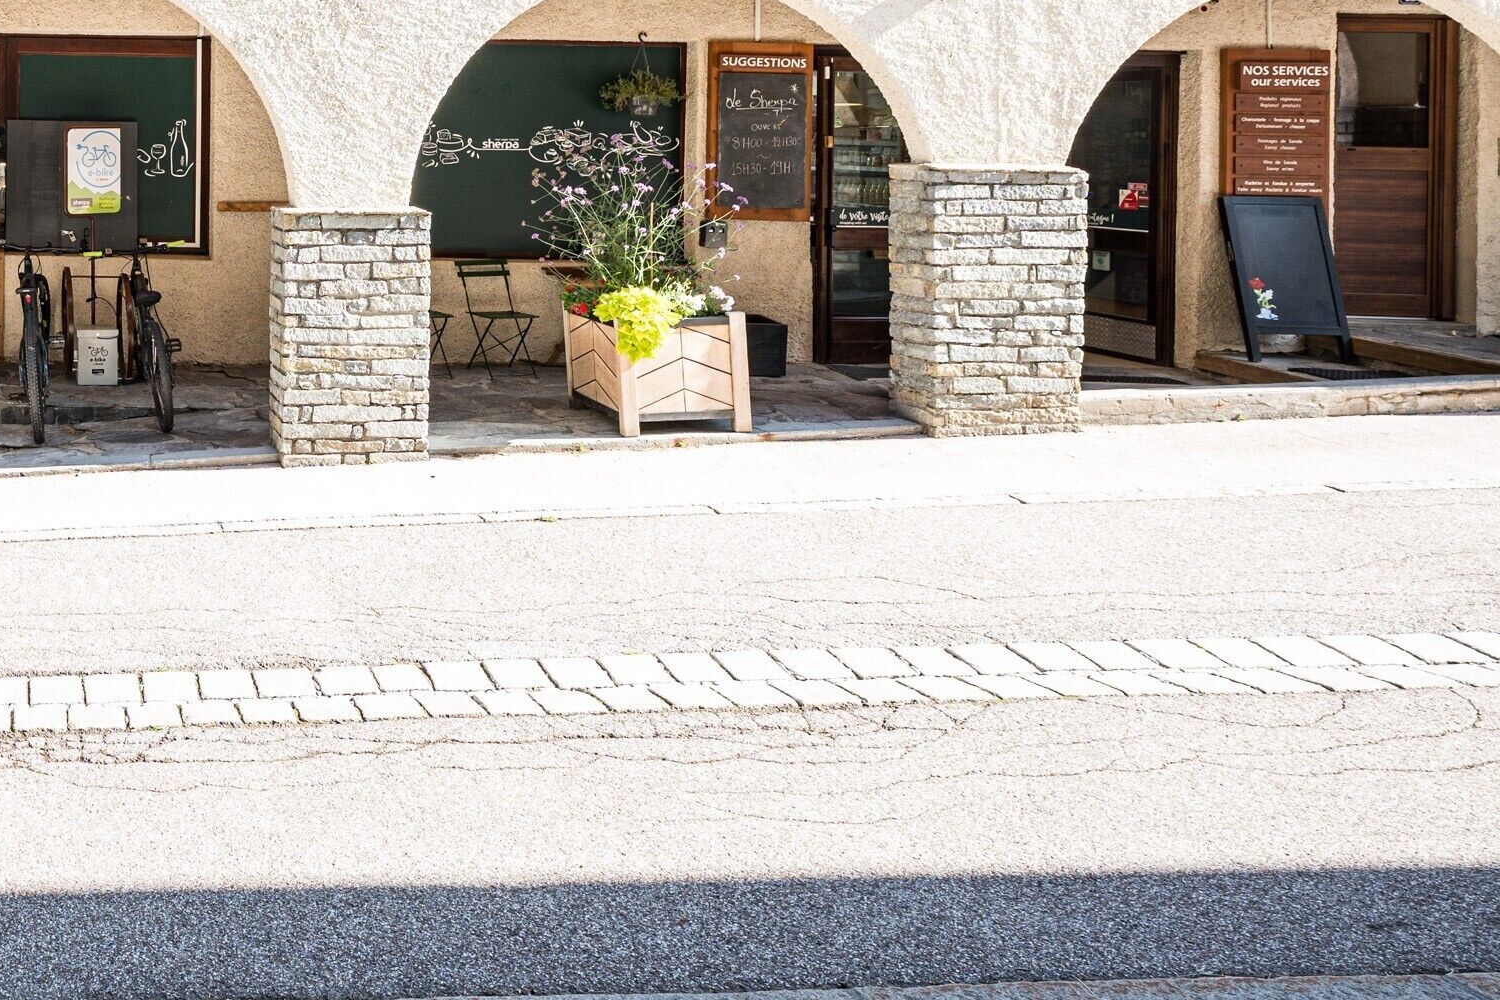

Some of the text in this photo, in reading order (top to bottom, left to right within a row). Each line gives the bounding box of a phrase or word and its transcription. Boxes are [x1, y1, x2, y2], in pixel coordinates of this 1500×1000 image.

[722, 56, 807, 69] SUGGESTIONS
[1242, 65, 1329, 77] NOS SERVICES
[1251, 77, 1320, 87] our services
[482, 138, 519, 150] sherpa
[88, 167, 114, 177] e-bike
[839, 208, 848, 220] de
